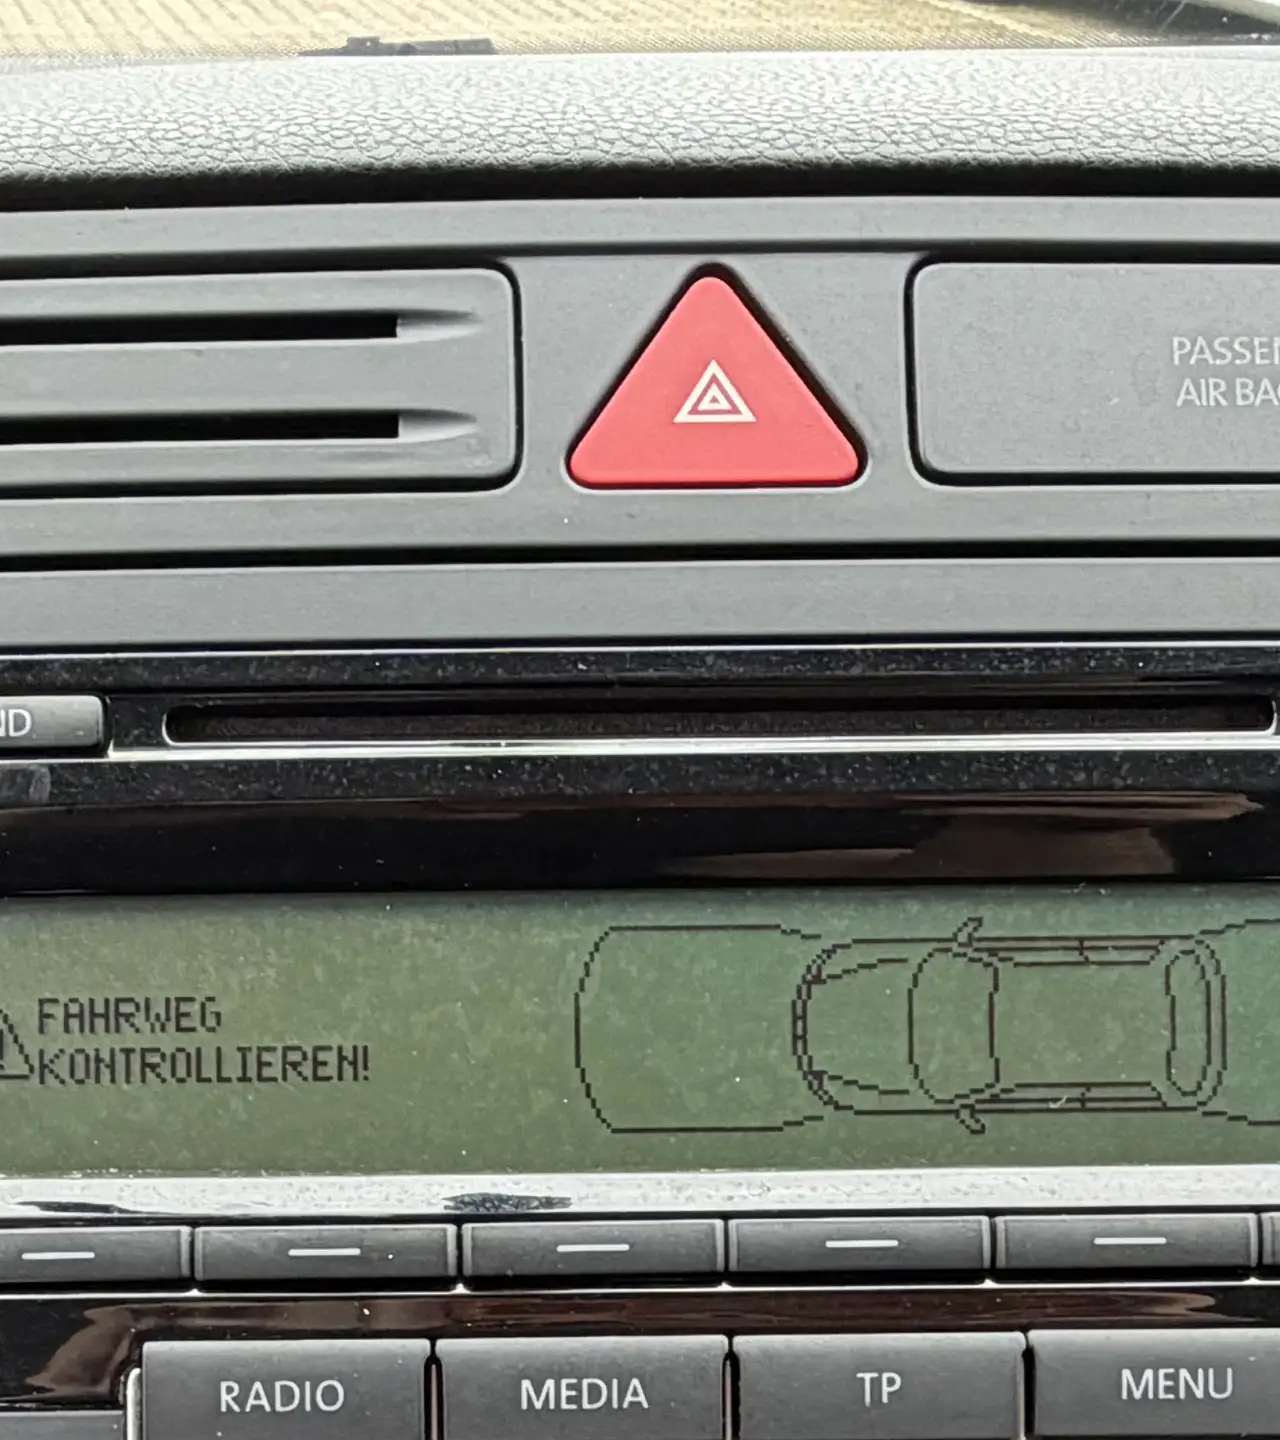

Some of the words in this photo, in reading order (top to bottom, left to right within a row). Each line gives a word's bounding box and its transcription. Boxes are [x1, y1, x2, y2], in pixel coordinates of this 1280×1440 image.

[1176, 377, 1228, 407] AIR
[37, 996, 222, 1036] FAHRWEG
[37, 1044, 371, 1086] KONTROLLIEREN!
[218, 1379, 347, 1413] RADIO
[519, 1376, 650, 1412] MEDIA
[856, 1371, 903, 1407] TP
[1120, 1367, 1235, 1400] MENU
